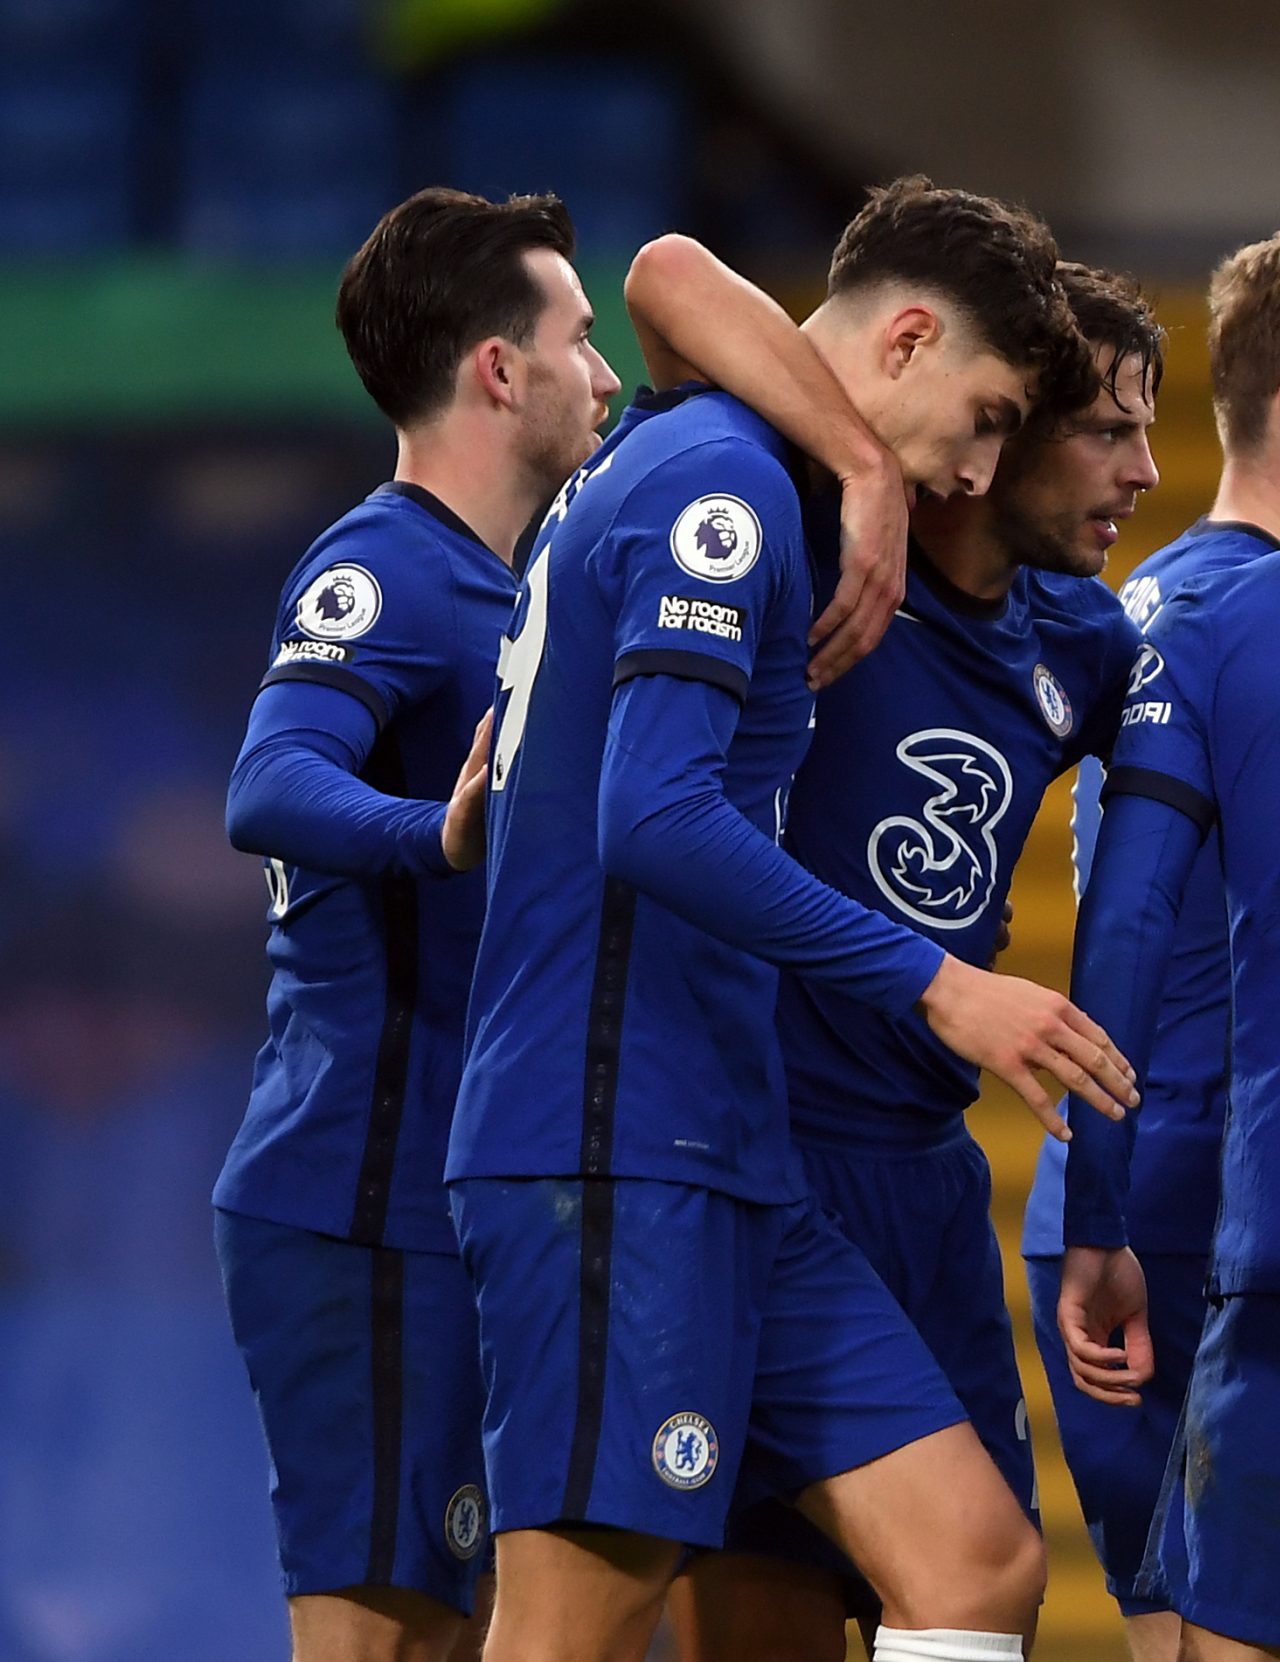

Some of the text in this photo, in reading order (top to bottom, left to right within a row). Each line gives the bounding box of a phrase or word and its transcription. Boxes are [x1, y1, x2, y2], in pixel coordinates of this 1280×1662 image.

[661, 596, 739, 625] No room
[657, 611, 742, 642] for racism
[298, 641, 346, 661] room
[669, 1415, 710, 1435] CHELSEA
